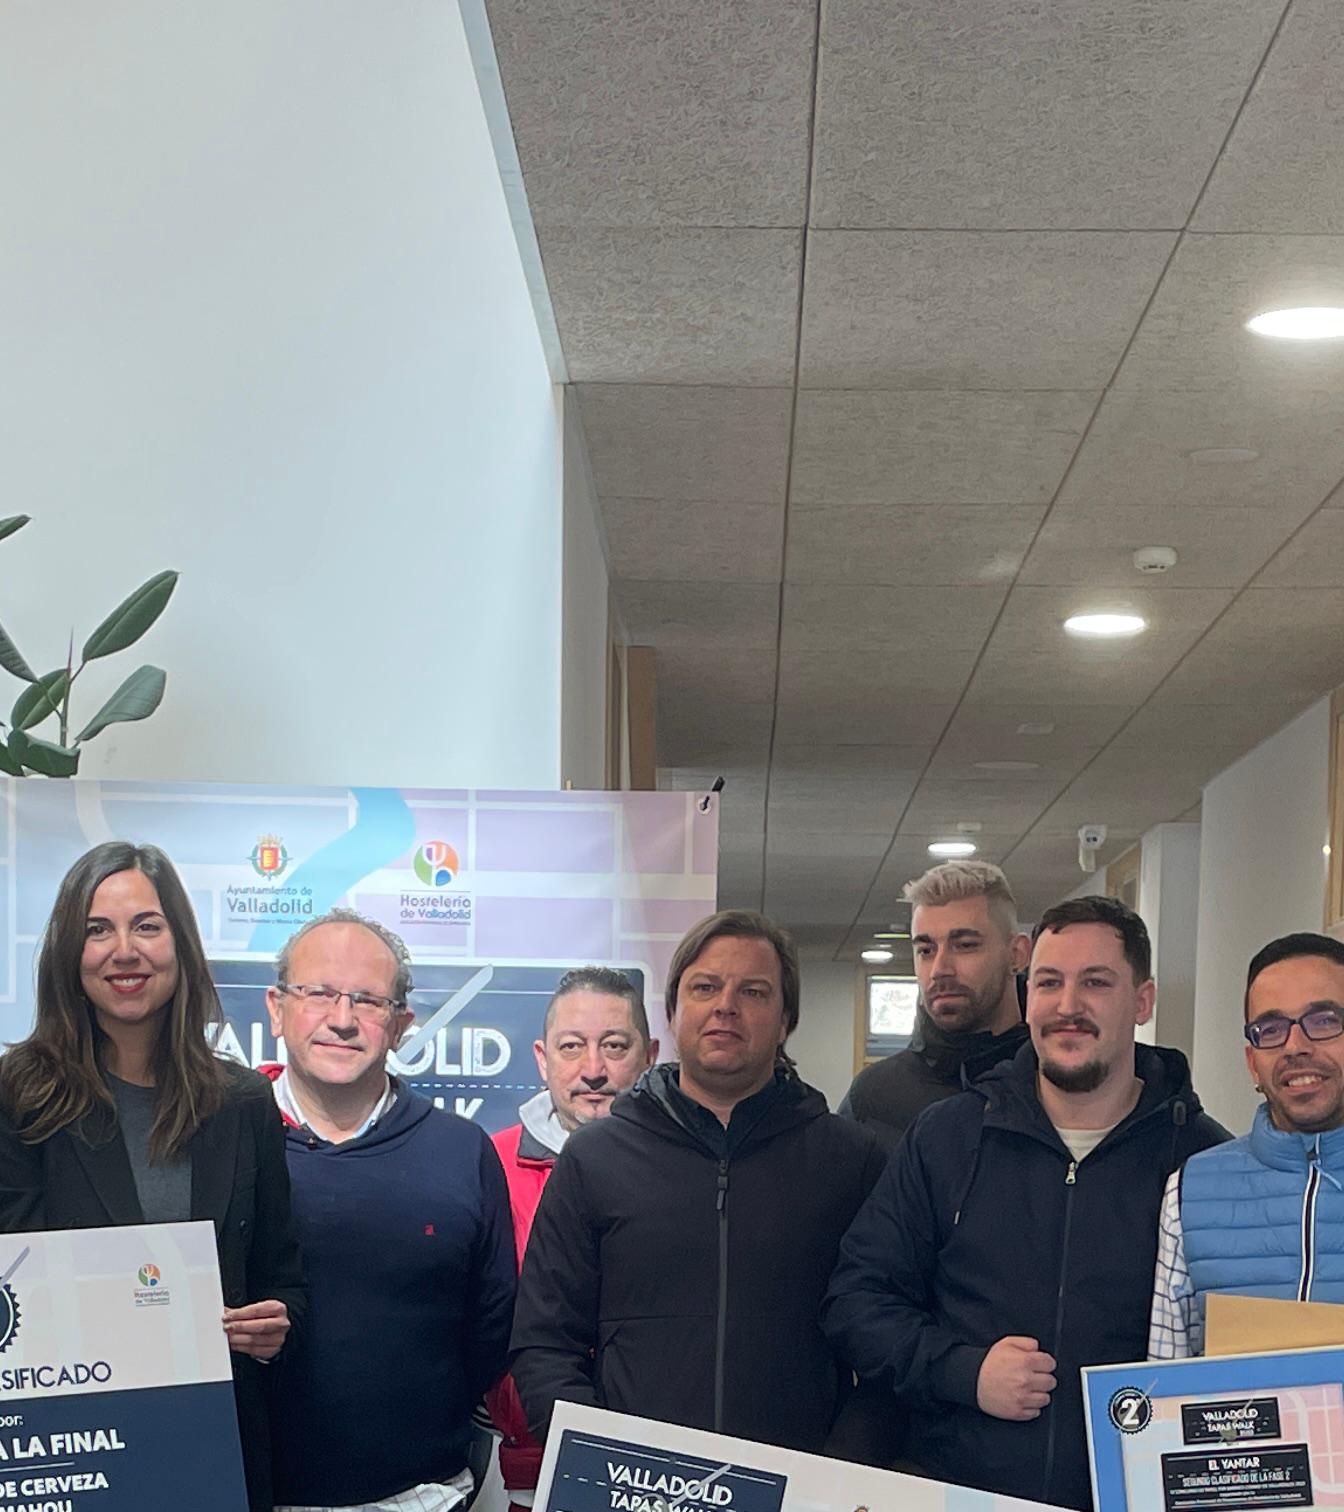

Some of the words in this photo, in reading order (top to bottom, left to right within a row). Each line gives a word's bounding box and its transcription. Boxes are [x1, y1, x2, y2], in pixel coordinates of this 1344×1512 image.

[227, 884, 297, 895] Ayuntamiento
[301, 886, 312, 895] de
[227, 898, 312, 914] Valladolid
[400, 908, 415, 918] de
[418, 909, 471, 919] Valladolid
[12, 1436, 46, 1459] LA
[50, 1429, 126, 1456] FINAL
[1221, 1457, 1260, 1469] YANTAR
[21, 1472, 109, 1496] CERVEZA
[607, 1462, 733, 1506] VALLADOLID
